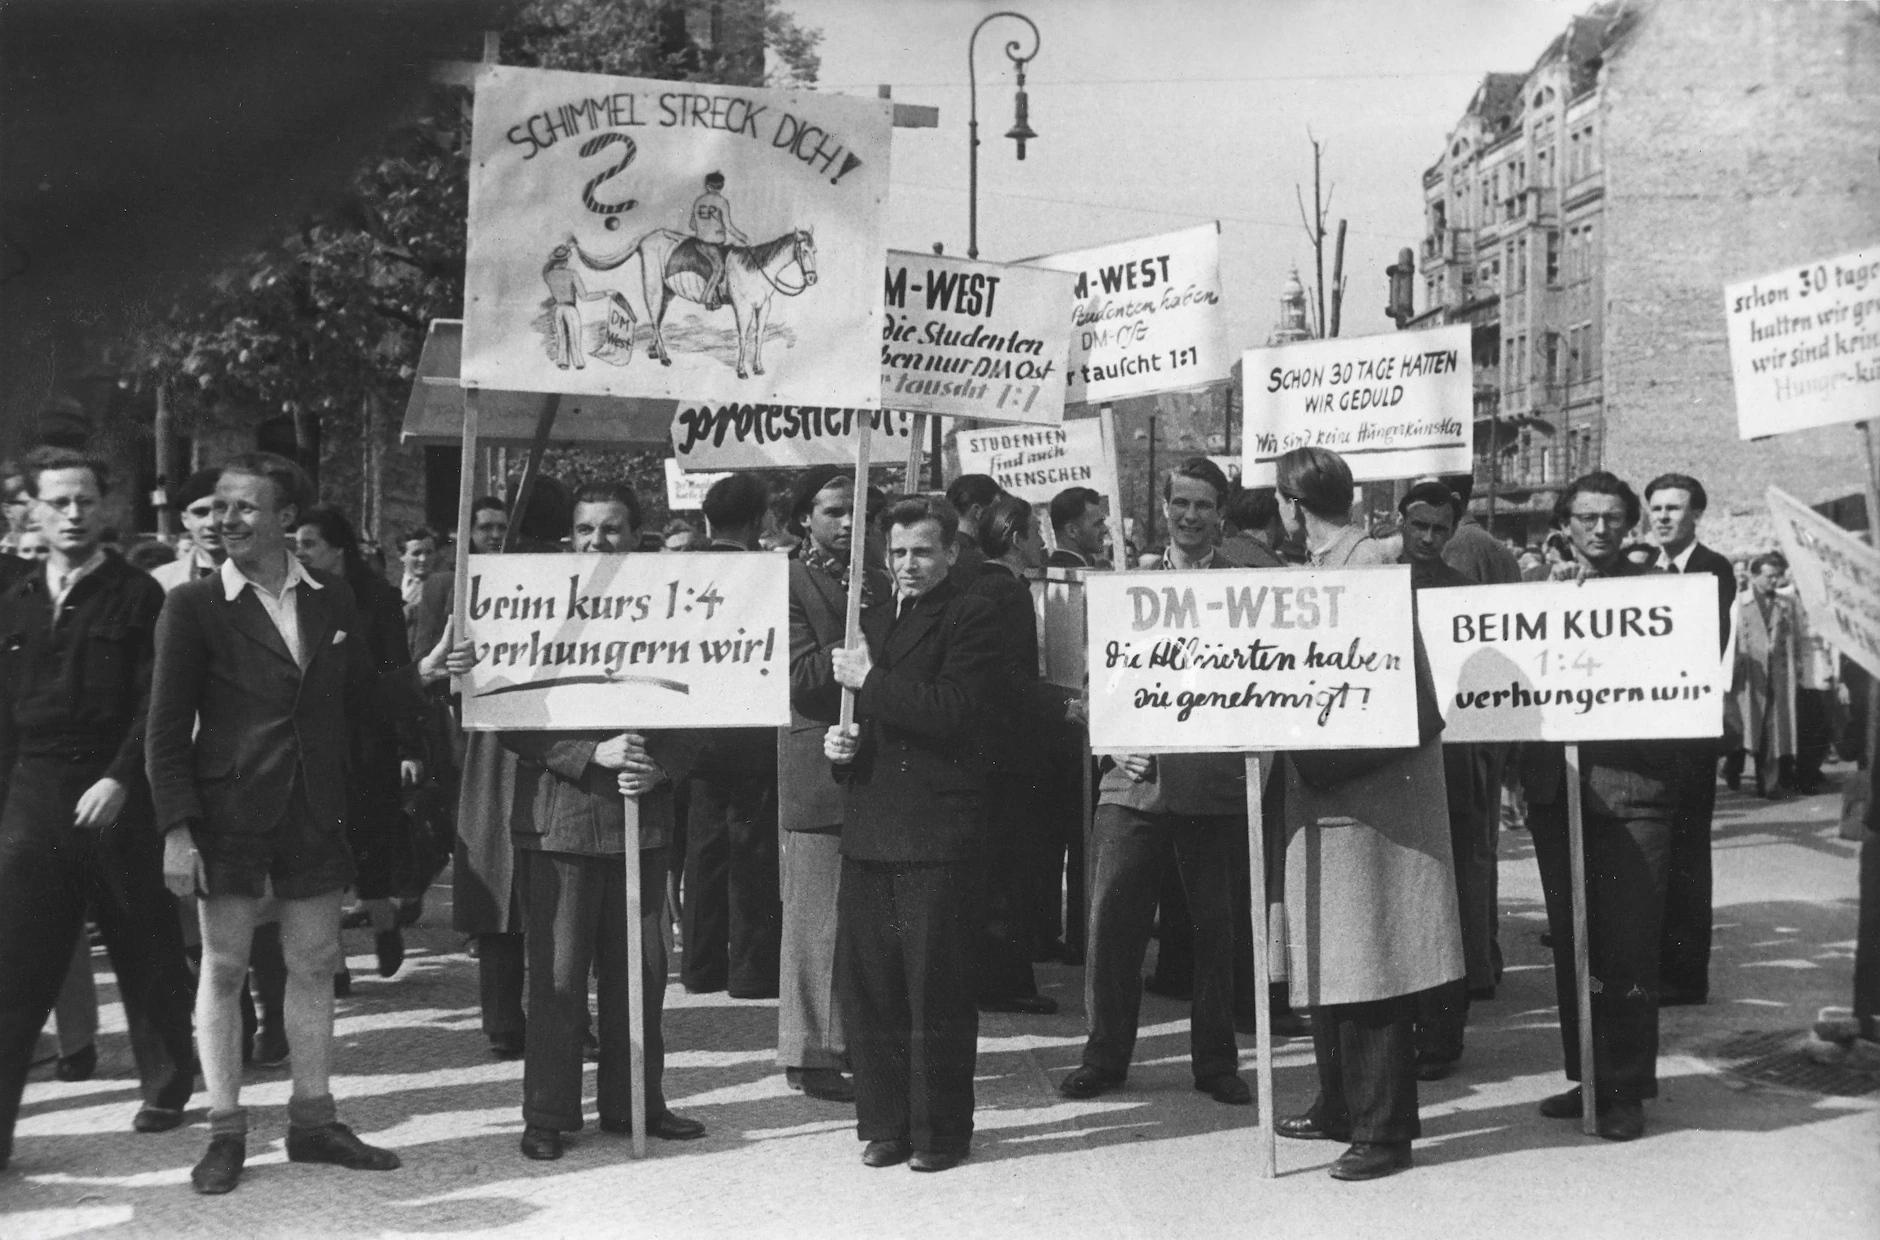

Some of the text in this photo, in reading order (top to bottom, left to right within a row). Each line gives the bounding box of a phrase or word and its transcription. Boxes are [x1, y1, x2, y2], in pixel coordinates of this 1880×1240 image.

[506, 93, 863, 185] SCHIMMEL STRECK DICH!
[698, 204, 720, 221] ER
[1799, 265, 1828, 297] 30
[611, 309, 630, 332] DM
[1817, 300, 1849, 326] wir
[883, 313, 1044, 356] die Studenten
[924, 355, 973, 374] nur
[1169, 346, 1197, 369] 1:1
[1267, 350, 1458, 393] SCHON 30 TAGE HATTEN
[1752, 348, 1786, 373] wir
[1790, 335, 1830, 367] sind
[895, 373, 989, 399] tauscht
[996, 384, 1040, 412] 1:1
[1305, 384, 1404, 414] WIR GEDULD
[970, 429, 1067, 453] STUDENTEN
[998, 465, 1091, 488] MENSCHEN
[469, 573, 724, 623] beim kurs 1:4
[1126, 585, 1346, 631] DM-WEST
[1452, 605, 1674, 643] BEIM KURS
[699, 626, 776, 676] wir!
[1302, 637, 1400, 672] haben
[1533, 649, 1603, 677] 1:4
[1176, 680, 1372, 727] genehmigt!
[1456, 670, 1712, 715] verhungern wir
